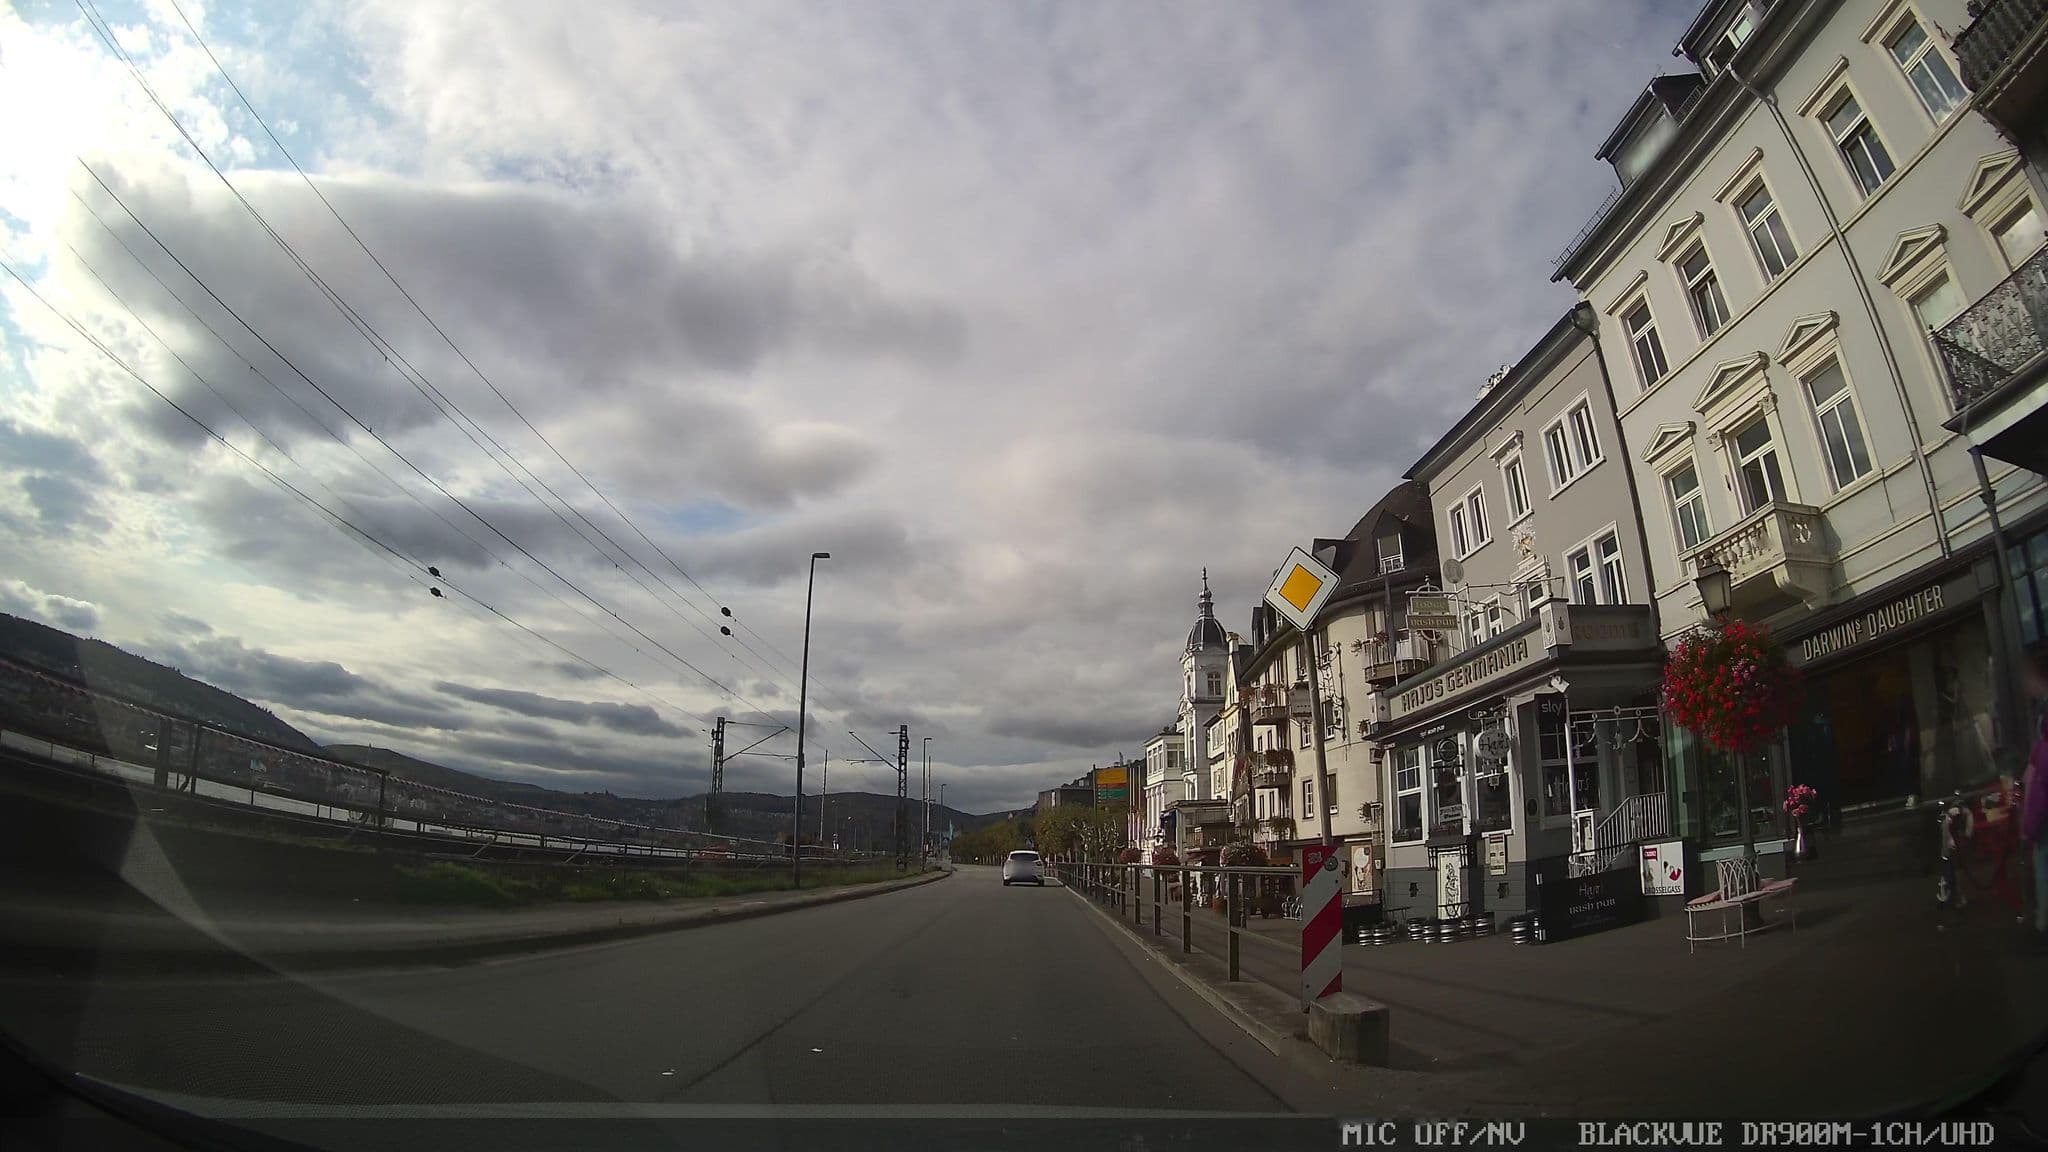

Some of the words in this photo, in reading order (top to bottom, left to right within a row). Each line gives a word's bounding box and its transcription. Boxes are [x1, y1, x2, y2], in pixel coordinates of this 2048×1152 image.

[1867, 585, 1944, 641] DAUGHTER
[1446, 638, 1528, 692] GERMANIA
[1541, 699, 1562, 716] sky
